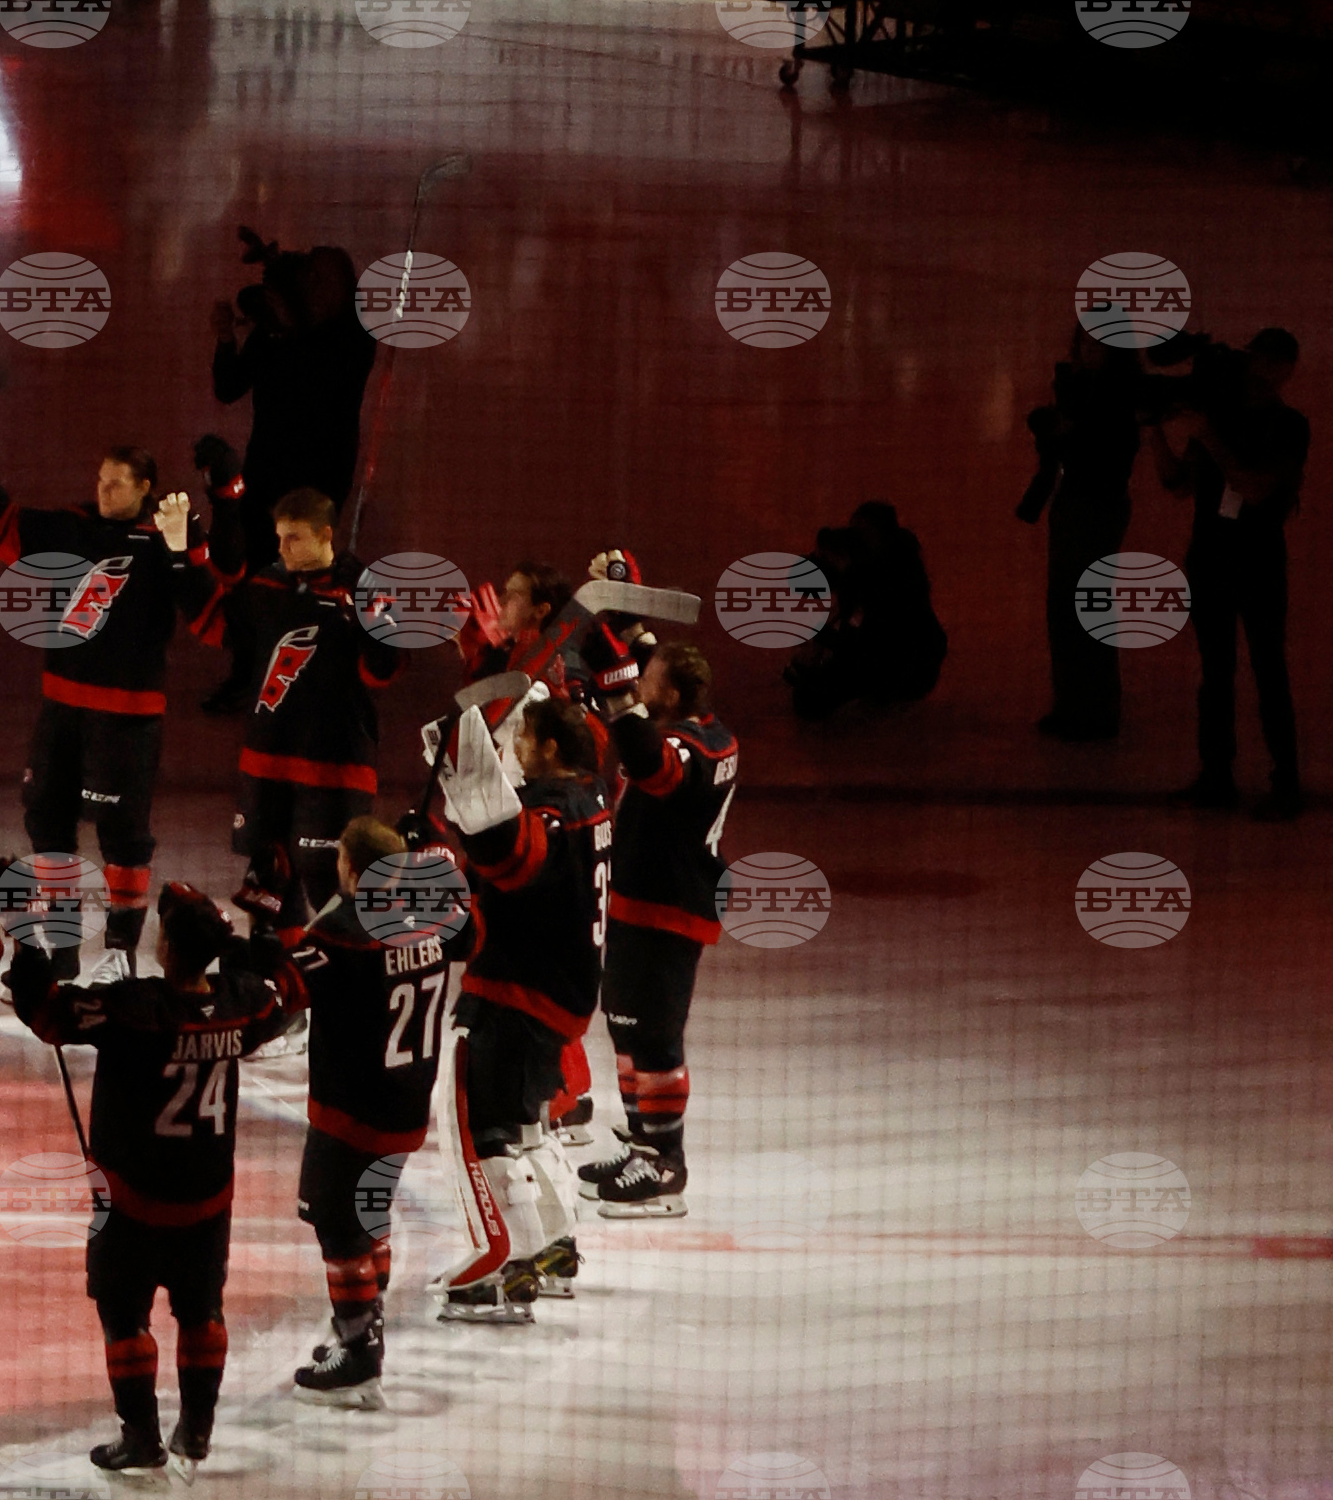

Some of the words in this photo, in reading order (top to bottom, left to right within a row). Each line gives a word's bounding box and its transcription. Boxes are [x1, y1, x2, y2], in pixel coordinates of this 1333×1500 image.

[385, 935, 444, 977] EHLERS
[172, 1029, 244, 1062] JARVIS
[384, 970, 447, 1070] 27
[154, 1060, 231, 1138] 24
